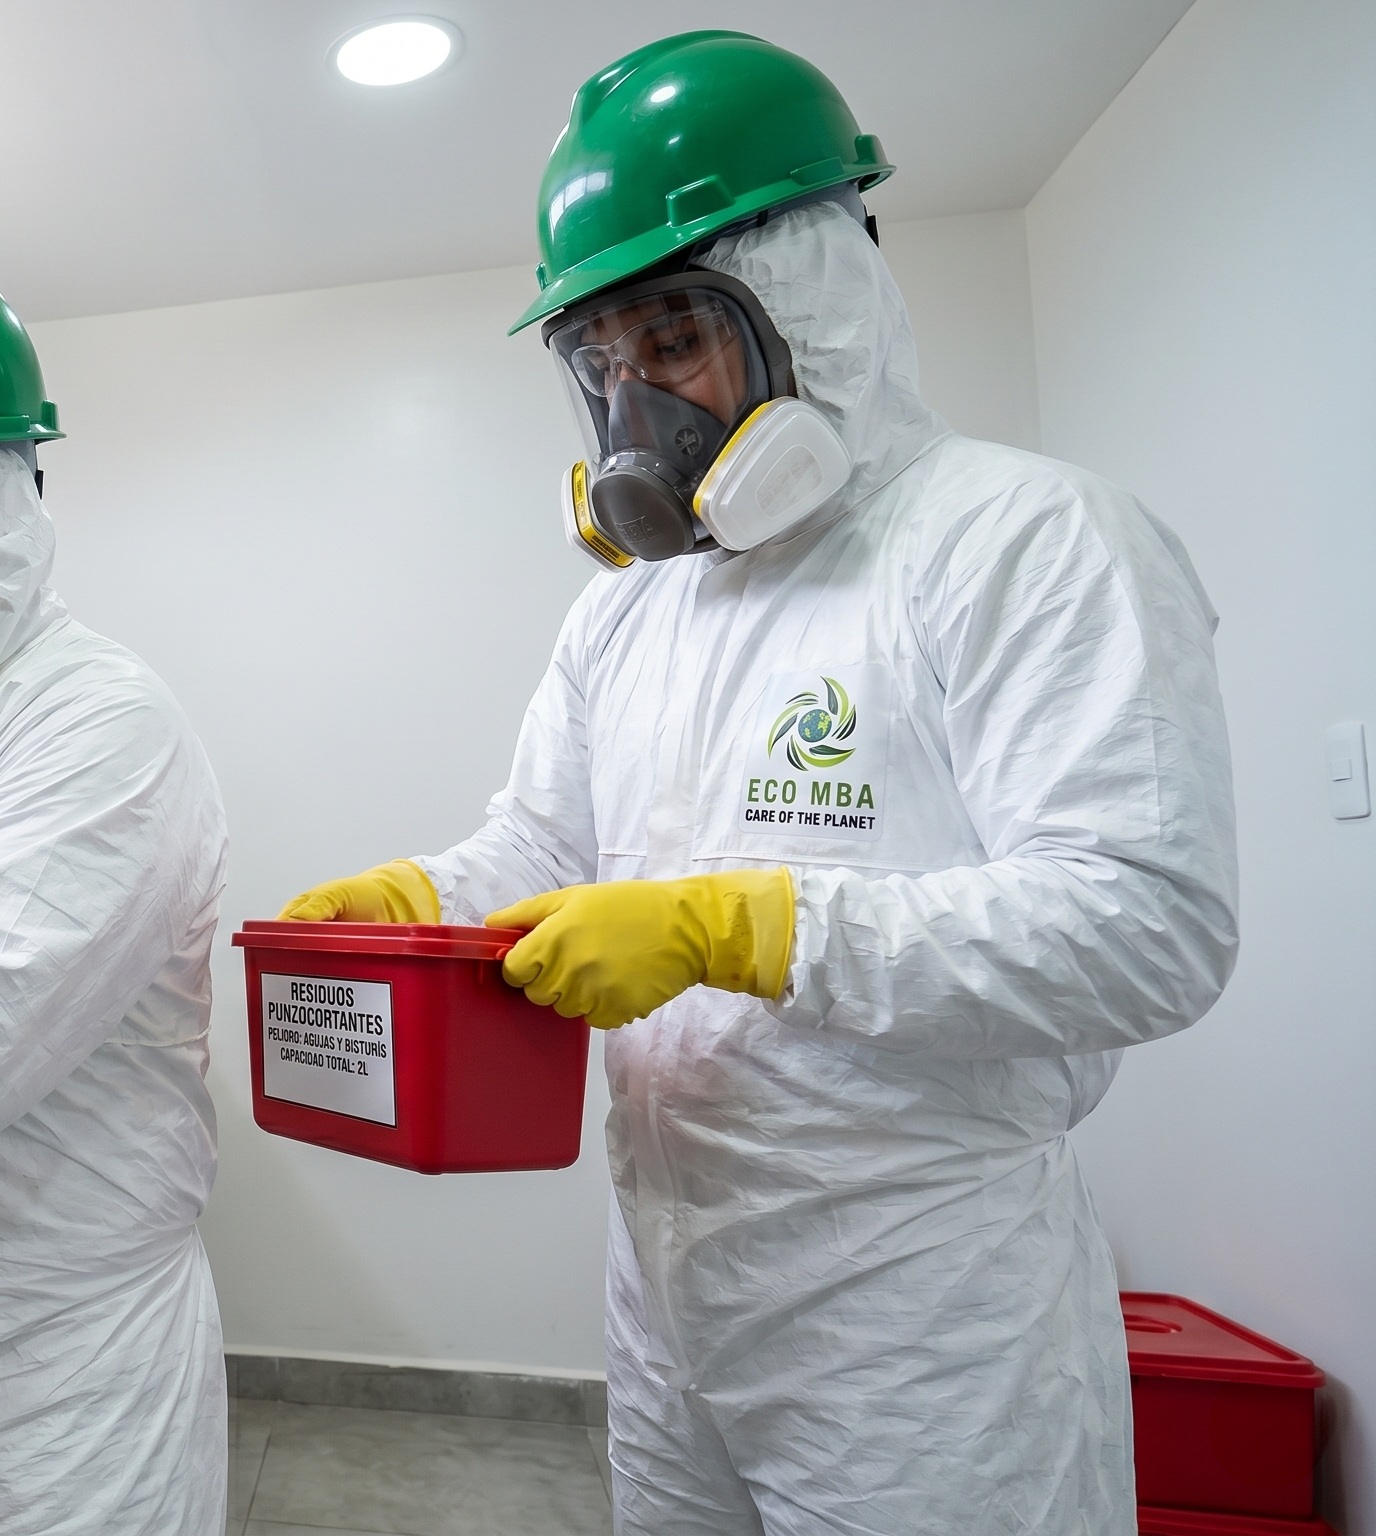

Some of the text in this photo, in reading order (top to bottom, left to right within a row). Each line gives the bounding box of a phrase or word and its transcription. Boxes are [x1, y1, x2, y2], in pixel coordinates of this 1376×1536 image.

[748, 779, 874, 809] ECO MBA
[746, 809, 875, 830] CARE OF THE PLANET
[291, 982, 354, 1007] RESIDUOS
[269, 1002, 383, 1035] PUNZOCORTANTES
[304, 1033, 334, 1050] AGUJAS
[337, 1038, 343, 1051] Y
[345, 1038, 386, 1058] BISTURÍS
[326, 1055, 355, 1073] TOTAL:
[358, 1061, 368, 1076] 2L
